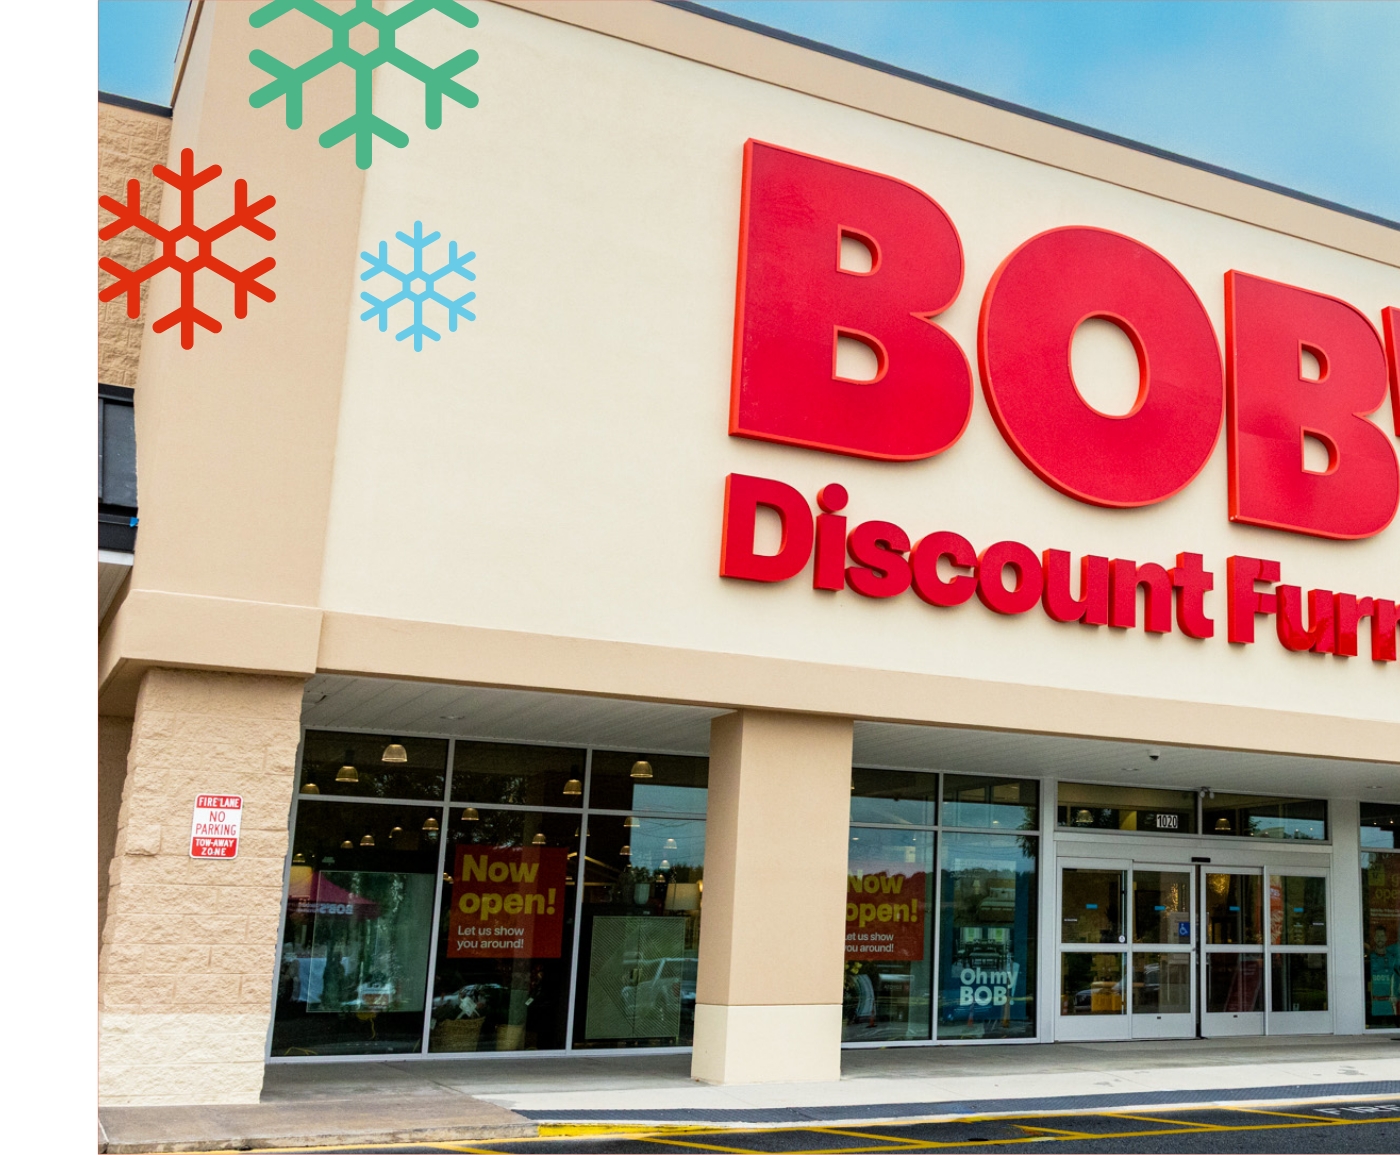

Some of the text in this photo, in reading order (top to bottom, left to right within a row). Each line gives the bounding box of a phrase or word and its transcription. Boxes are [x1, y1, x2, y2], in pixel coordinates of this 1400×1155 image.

[719, 472, 1214, 639] Discount
[199, 796, 240, 808] FIRE LANE
[209, 810, 226, 823] NO
[1157, 815, 1177, 828] 1020
[195, 823, 237, 836] PARKING
[195, 838, 234, 848] TOW-AWAY
[201, 847, 227, 856] ZONE
[462, 854, 540, 883] Now
[459, 888, 556, 921] open!
[846, 899, 918, 928] open!
[458, 925, 525, 936] Let us show
[858, 933, 868, 941] us
[870, 931, 894, 941] show
[457, 939, 524, 951] you around!
[860, 943, 894, 953] around!
[960, 967, 1018, 990] Oh my
